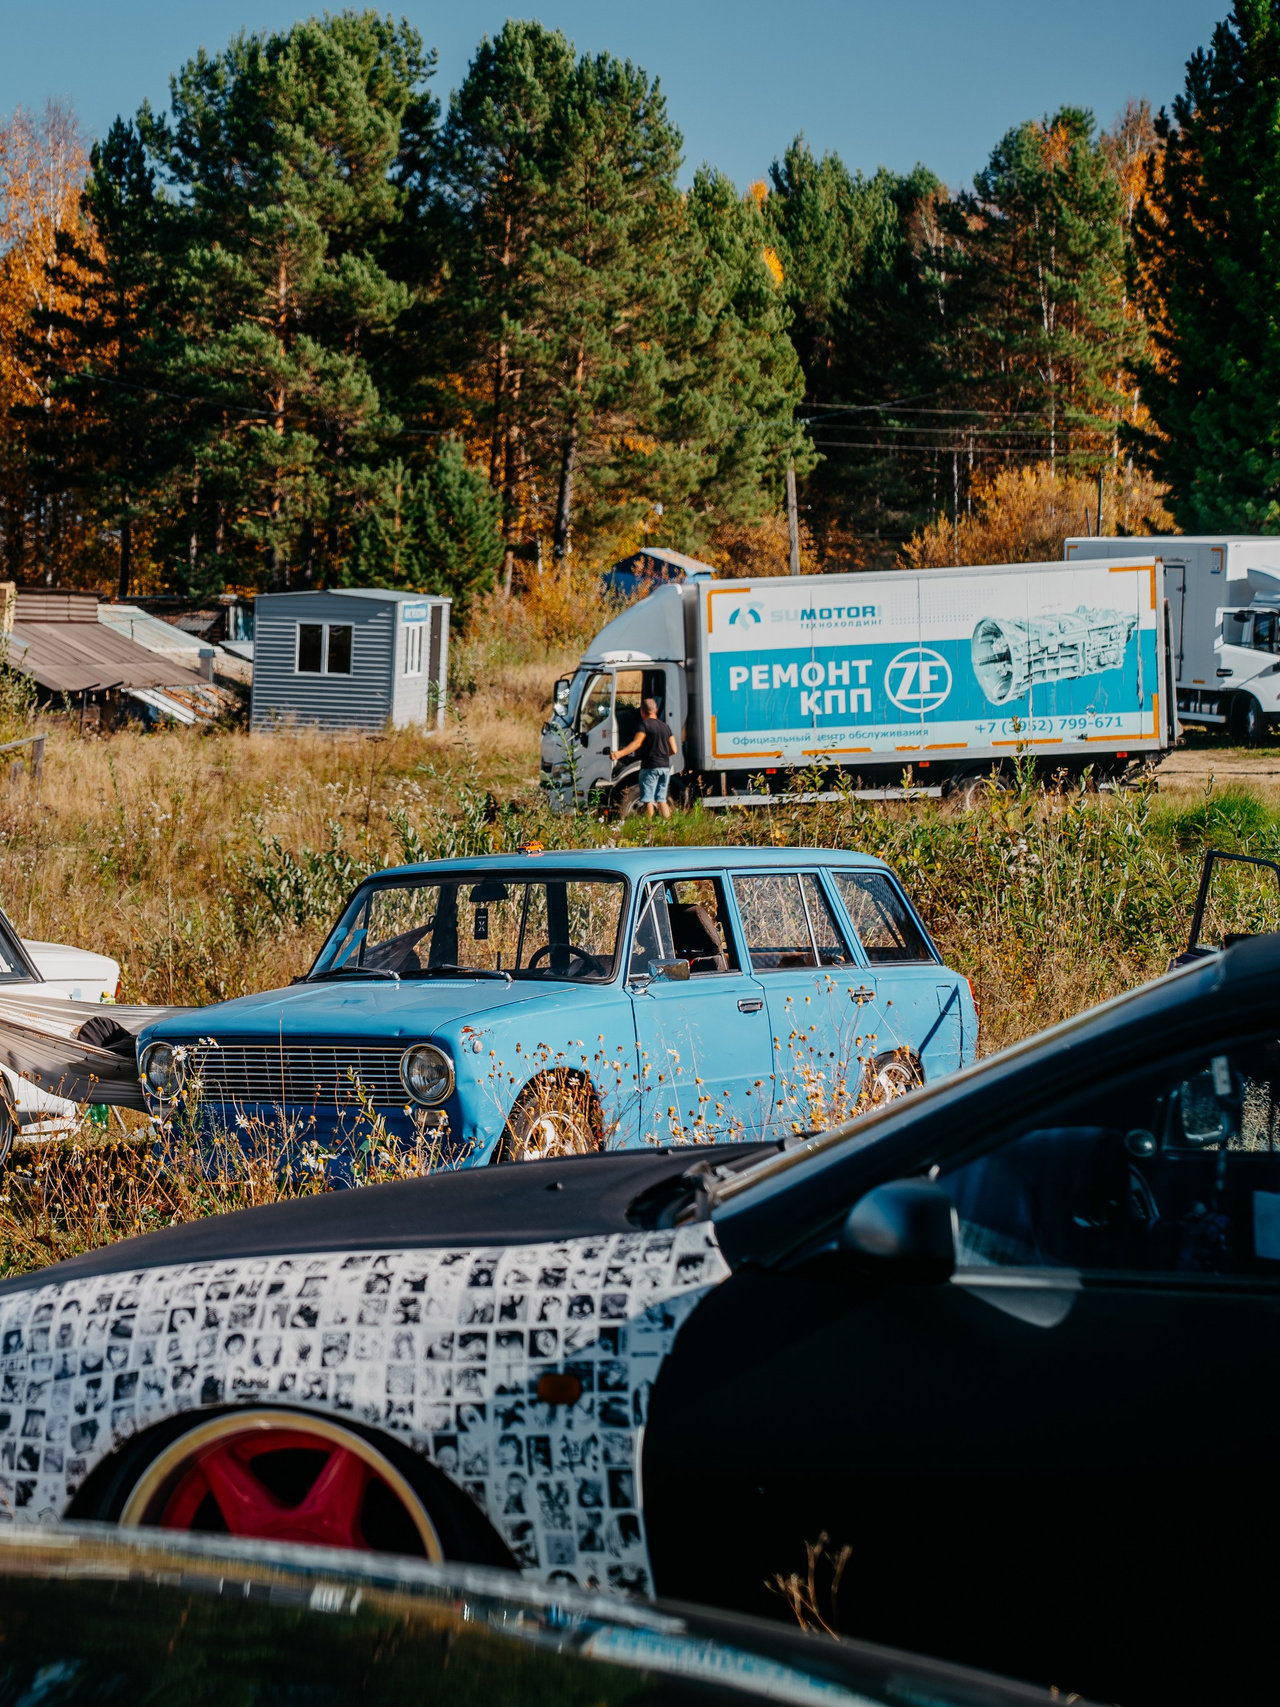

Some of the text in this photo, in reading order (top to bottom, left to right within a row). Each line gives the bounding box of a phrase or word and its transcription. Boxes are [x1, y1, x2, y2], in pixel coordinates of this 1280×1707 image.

[729, 659, 873, 692] РЕМОНТ
[891, 661, 945, 700] ZF
[800, 688, 871, 716] КПП
[732, 732, 811, 746] Официальный
[848, 728, 929, 741] обслуживания
[1059, 716, 1124, 730] 799-671
